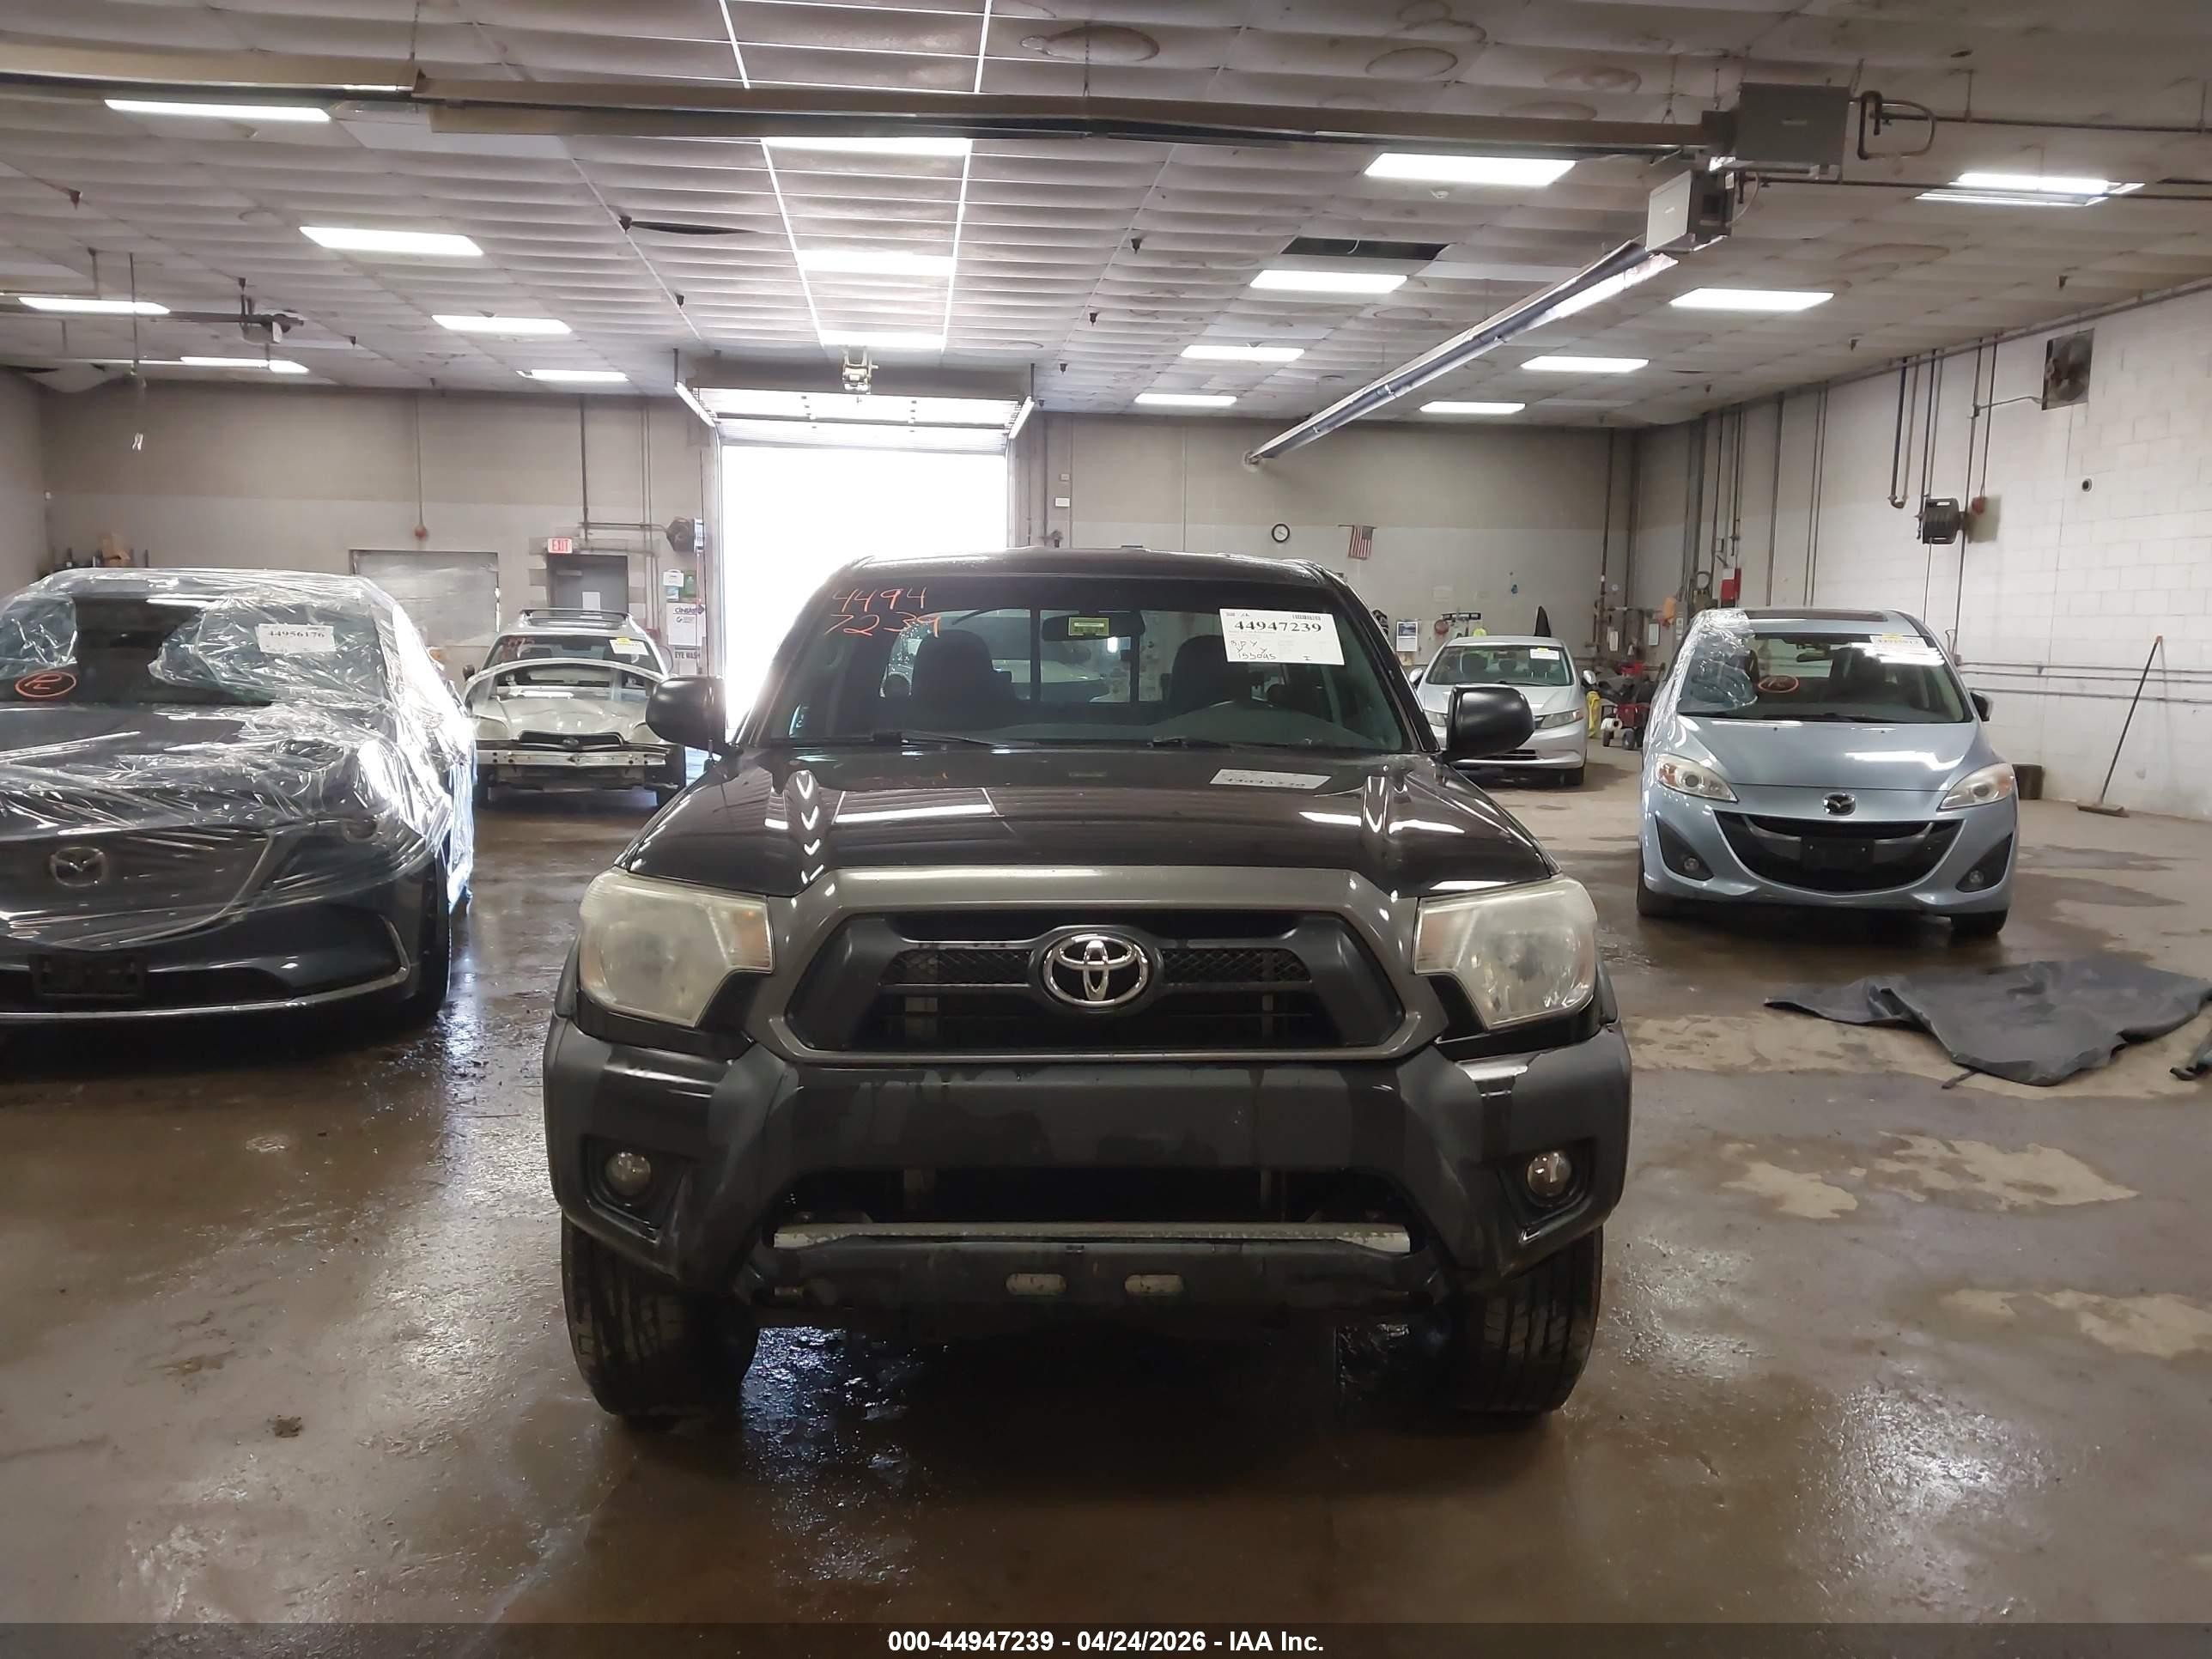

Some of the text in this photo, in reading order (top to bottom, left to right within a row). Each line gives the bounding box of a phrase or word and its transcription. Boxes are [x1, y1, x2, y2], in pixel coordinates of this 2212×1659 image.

[551, 539, 568, 551] EXIT
[831, 586, 927, 612] 4494
[824, 611, 942, 638] 7239
[1234, 620, 1322, 633] 44947239
